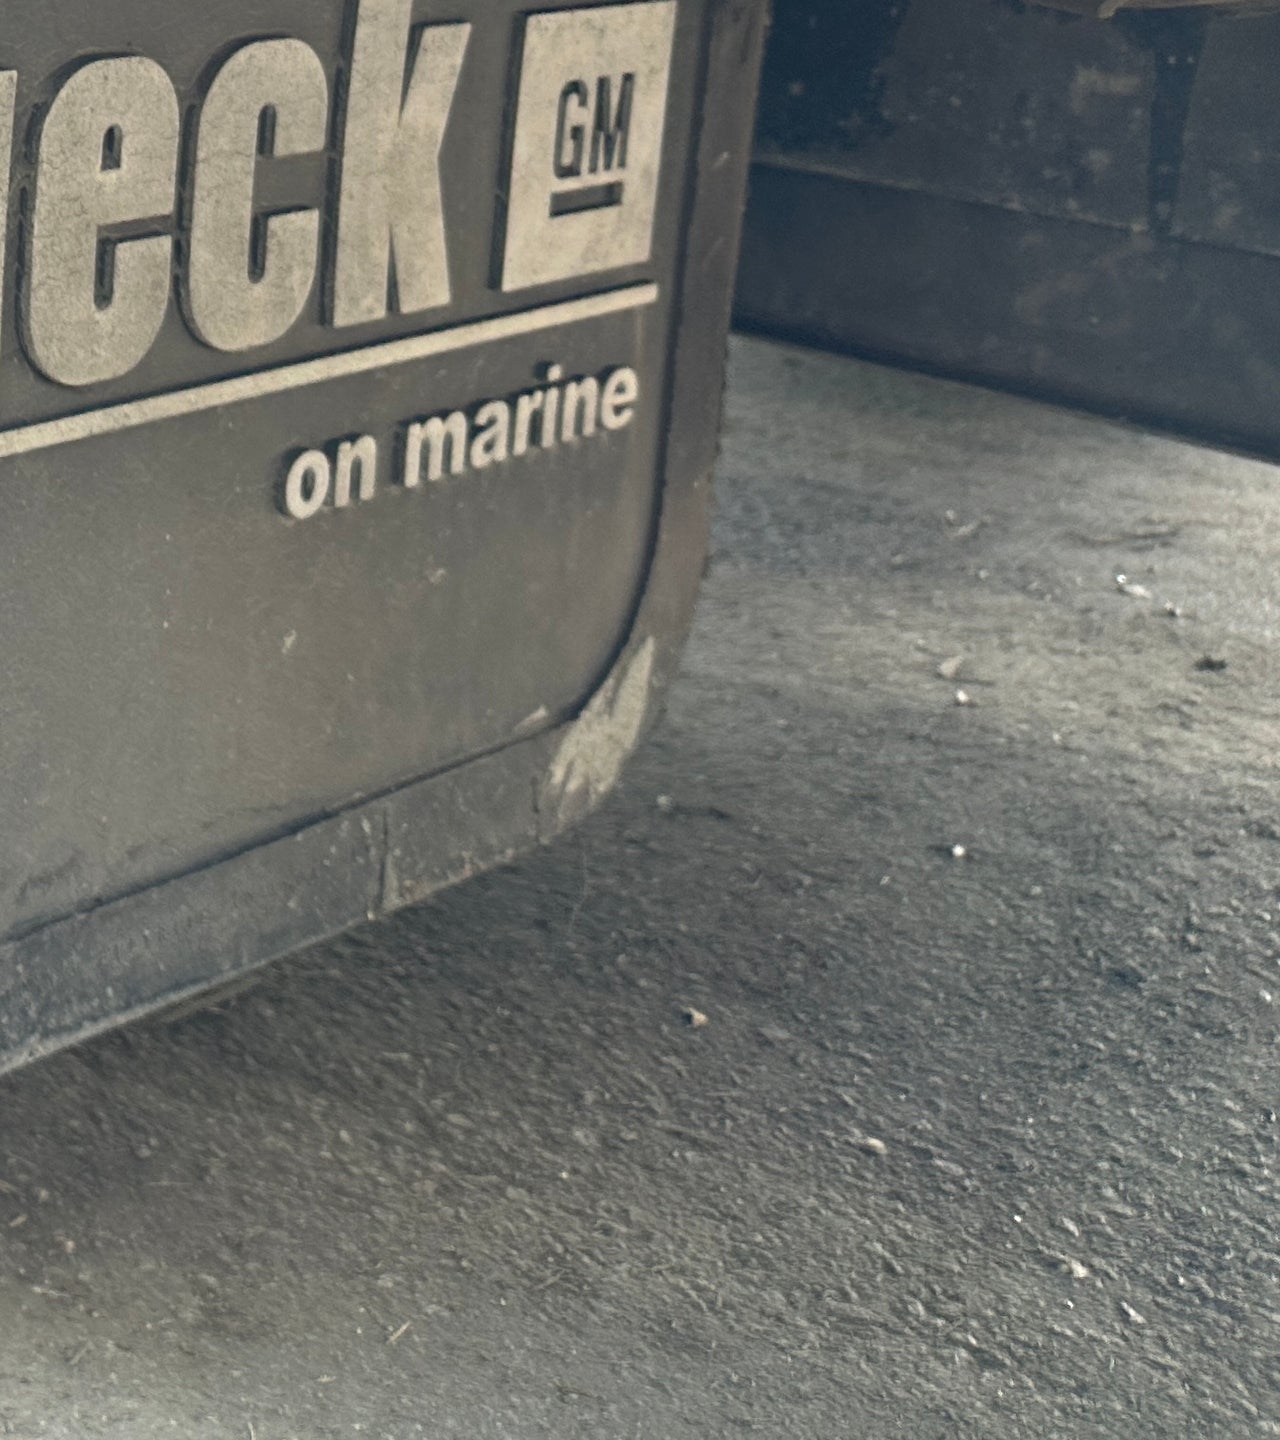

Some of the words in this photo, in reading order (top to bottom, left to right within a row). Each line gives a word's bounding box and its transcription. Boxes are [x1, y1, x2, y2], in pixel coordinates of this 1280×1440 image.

[553, 73, 635, 180] GM
[282, 434, 378, 519] on
[401, 362, 641, 489] marine
